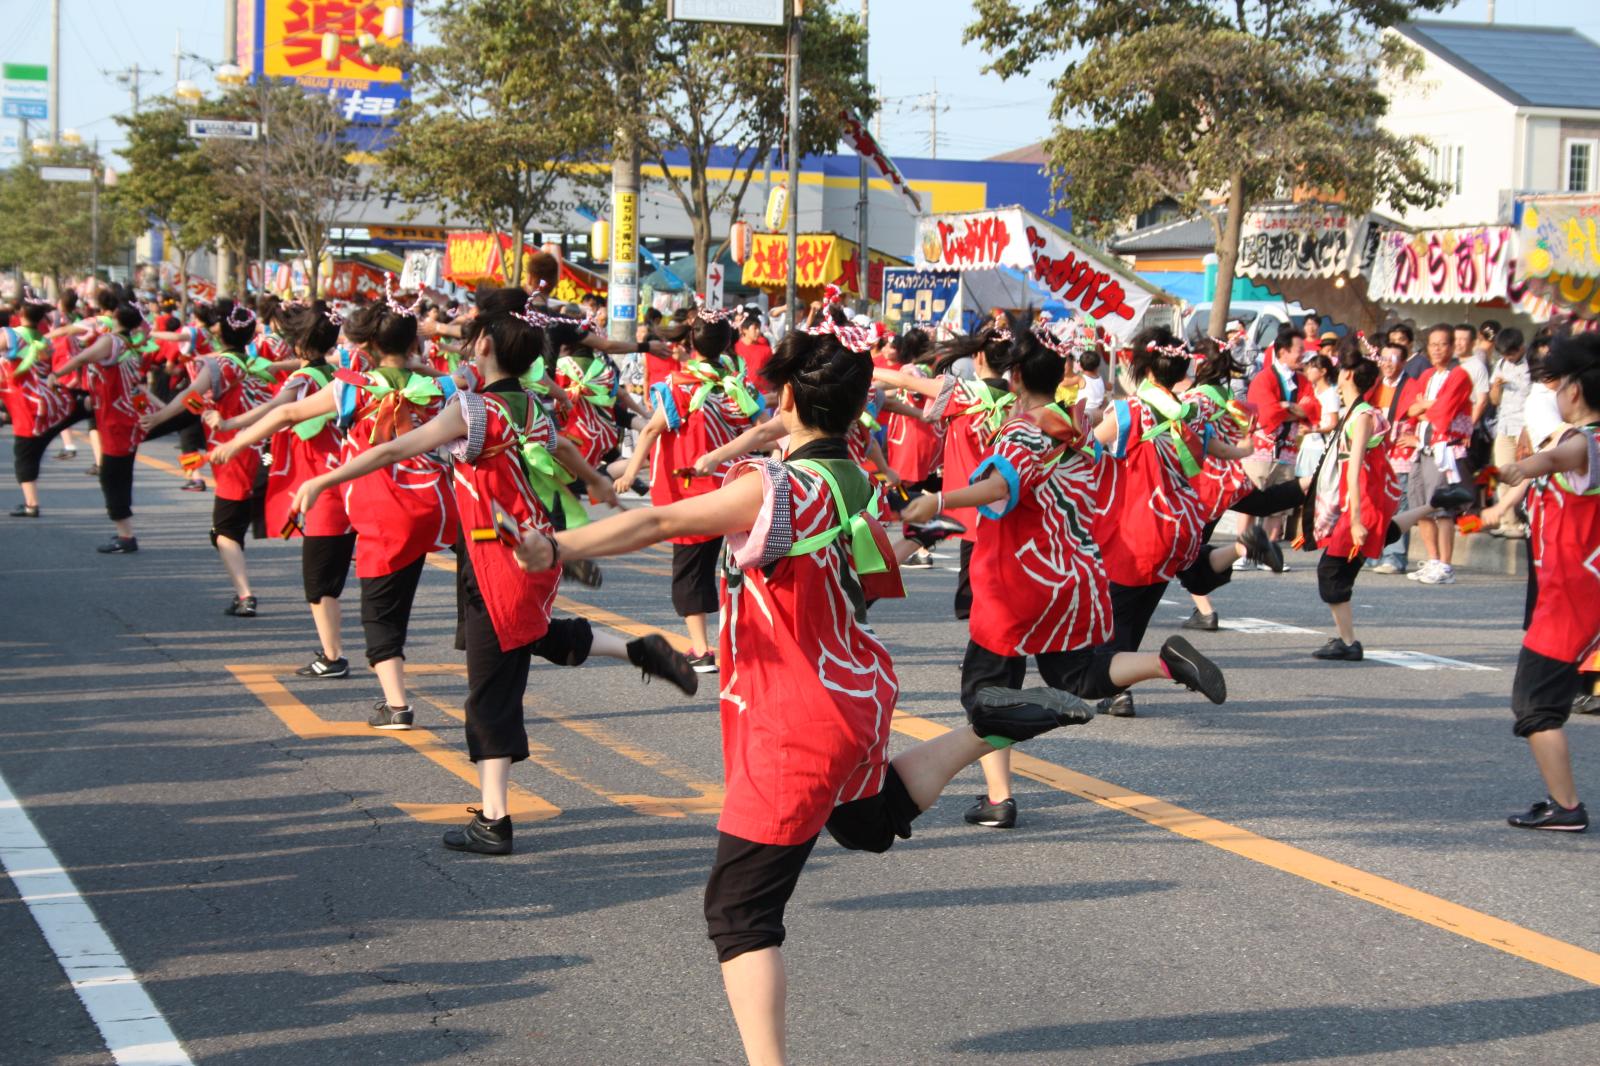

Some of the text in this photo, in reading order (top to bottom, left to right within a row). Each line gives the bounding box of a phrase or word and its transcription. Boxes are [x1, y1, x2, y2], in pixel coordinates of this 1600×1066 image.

[332, 77, 370, 91] STORE
[887, 273, 957, 289] ディスカウントスーパー
[886, 291, 946, 321] ヒーロー
